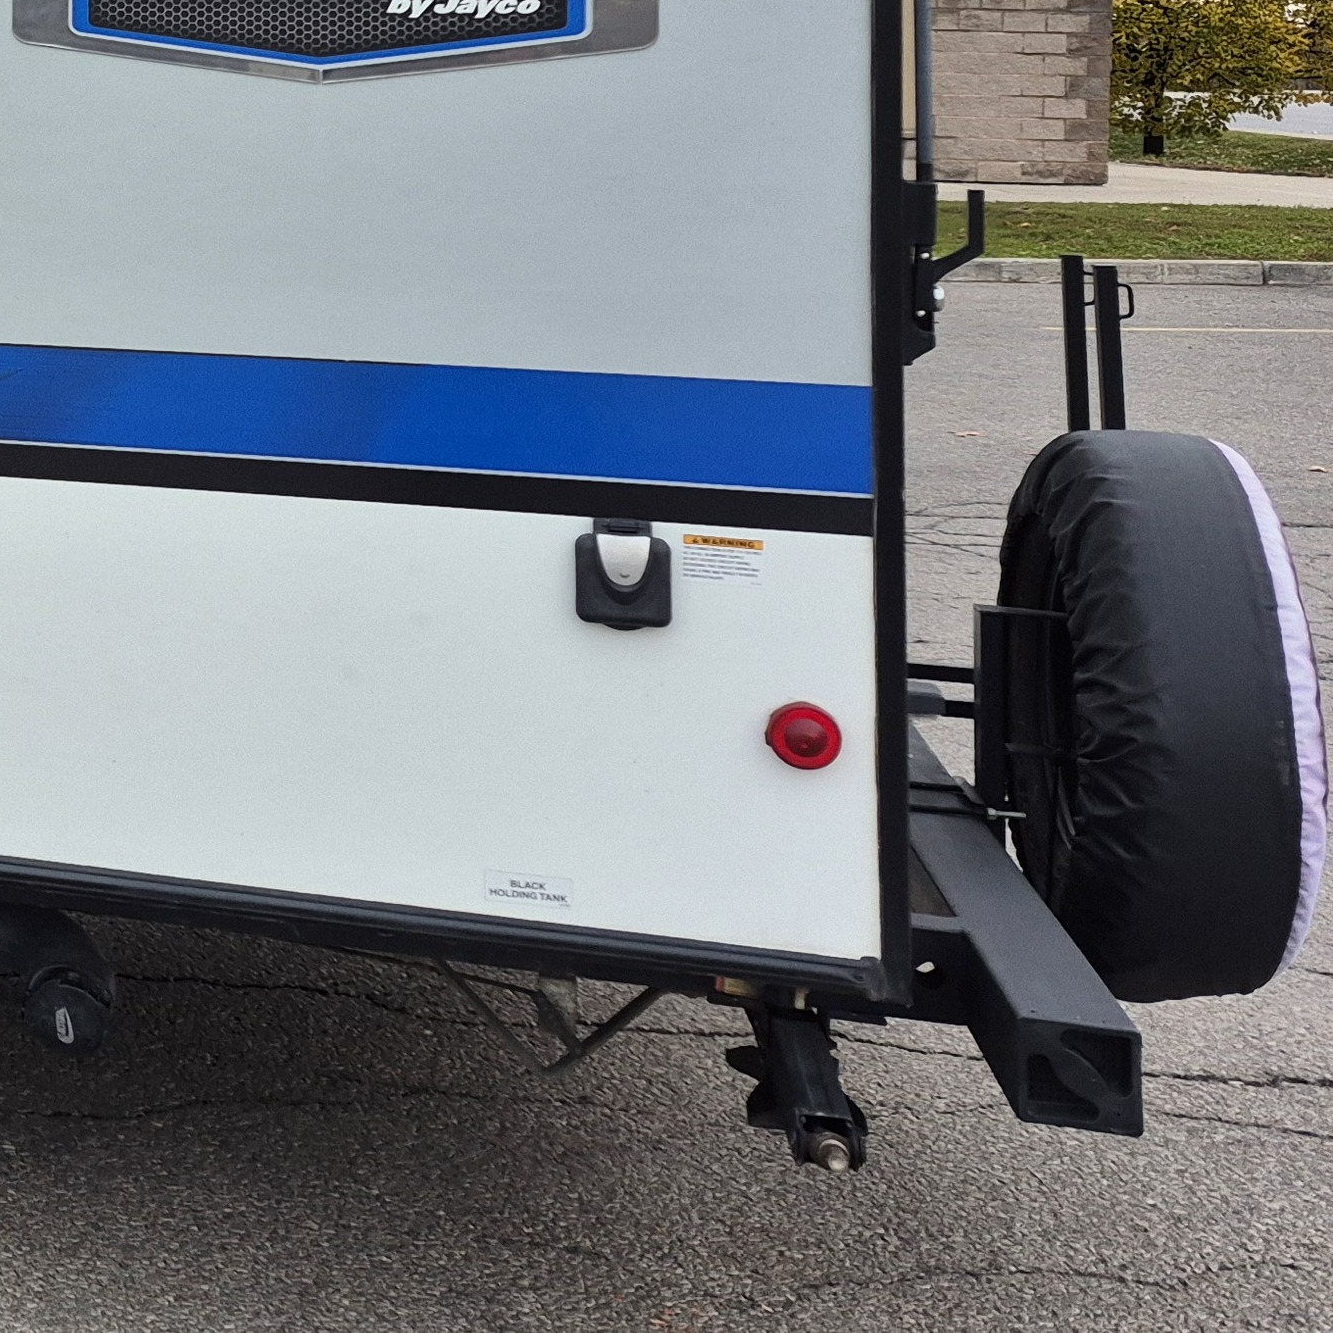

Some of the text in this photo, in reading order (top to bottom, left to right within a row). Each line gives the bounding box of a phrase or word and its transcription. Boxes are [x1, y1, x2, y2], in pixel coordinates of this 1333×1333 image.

[701, 538, 755, 549] WARNING
[510, 879, 547, 891] BLACK
[489, 888, 568, 903] HOLDING TANK
